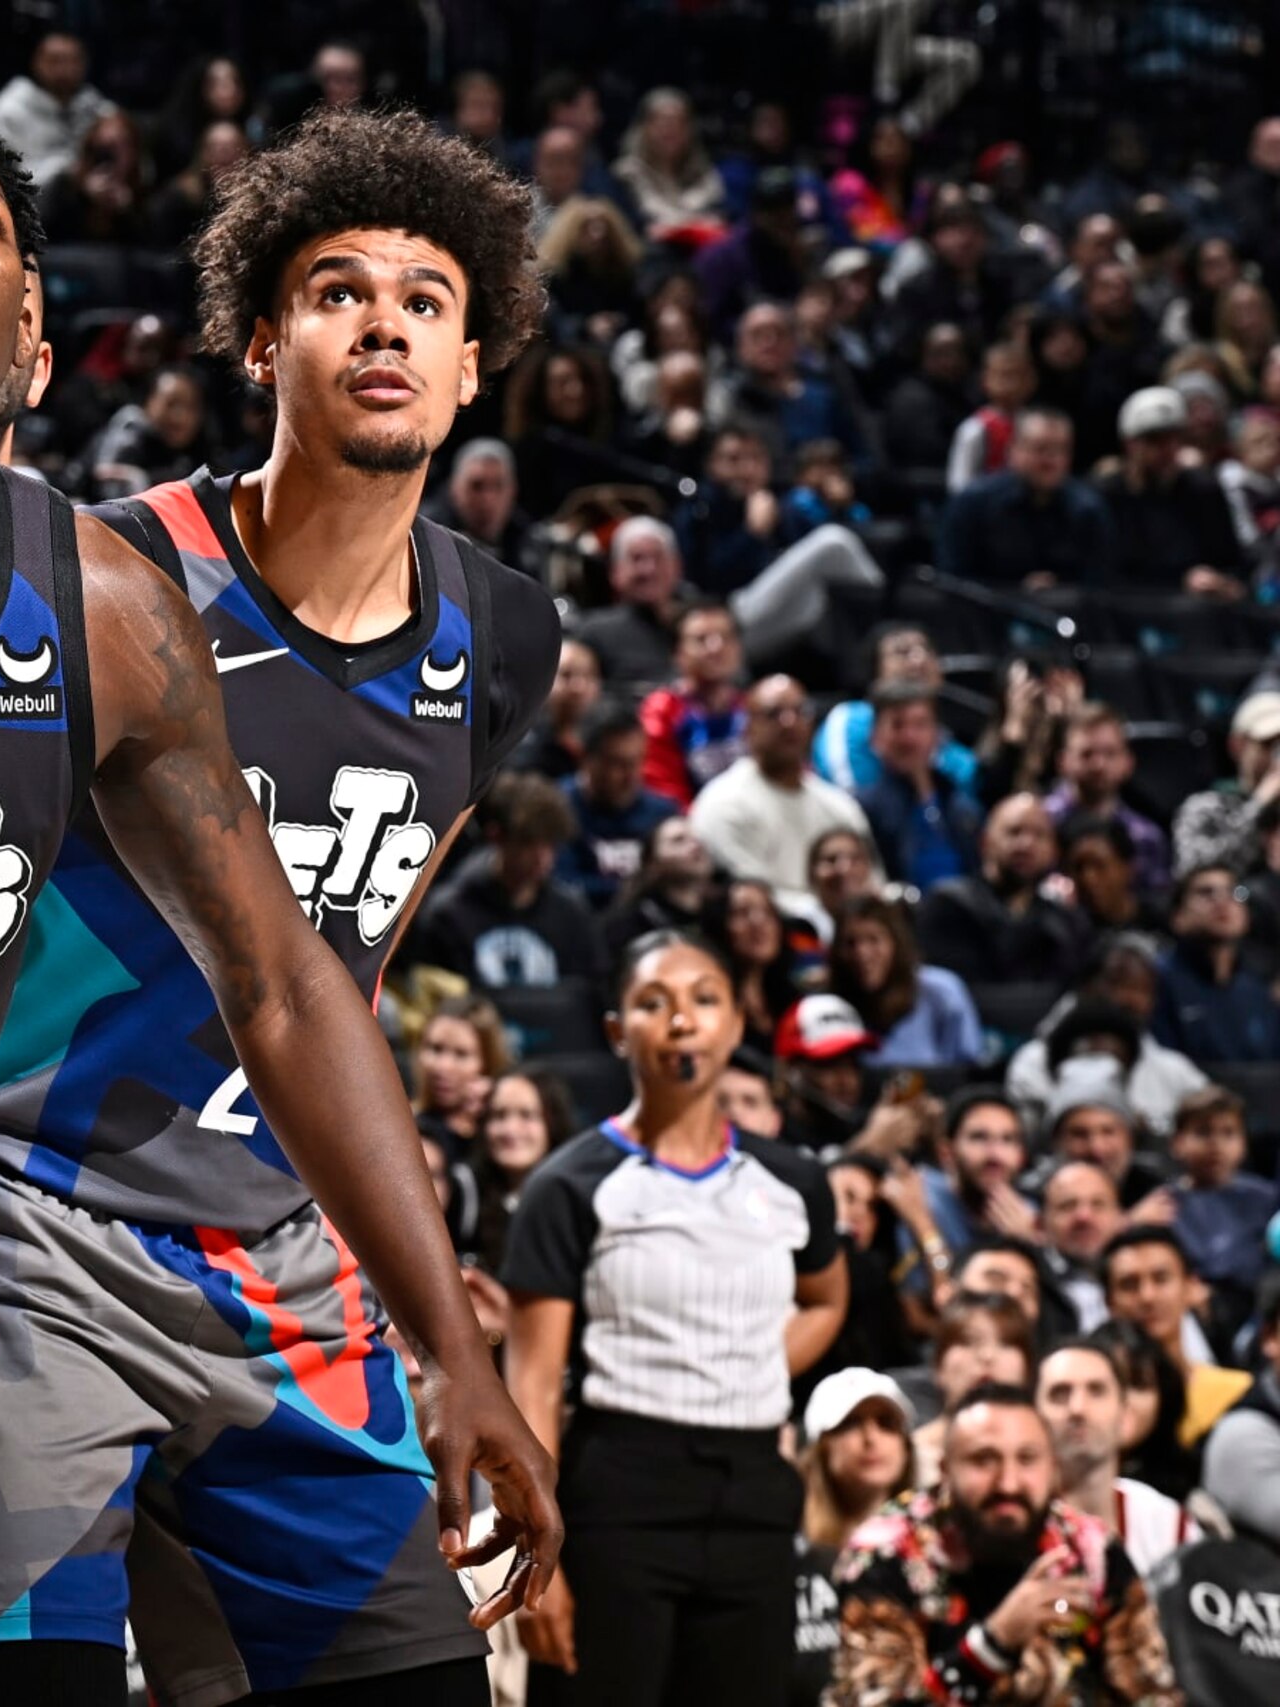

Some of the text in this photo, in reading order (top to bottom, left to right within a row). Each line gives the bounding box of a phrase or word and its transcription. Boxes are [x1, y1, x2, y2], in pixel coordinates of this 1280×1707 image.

[0, 693, 56, 714] Webull
[414, 698, 463, 720] Webull
[241, 765, 436, 947] ETS
